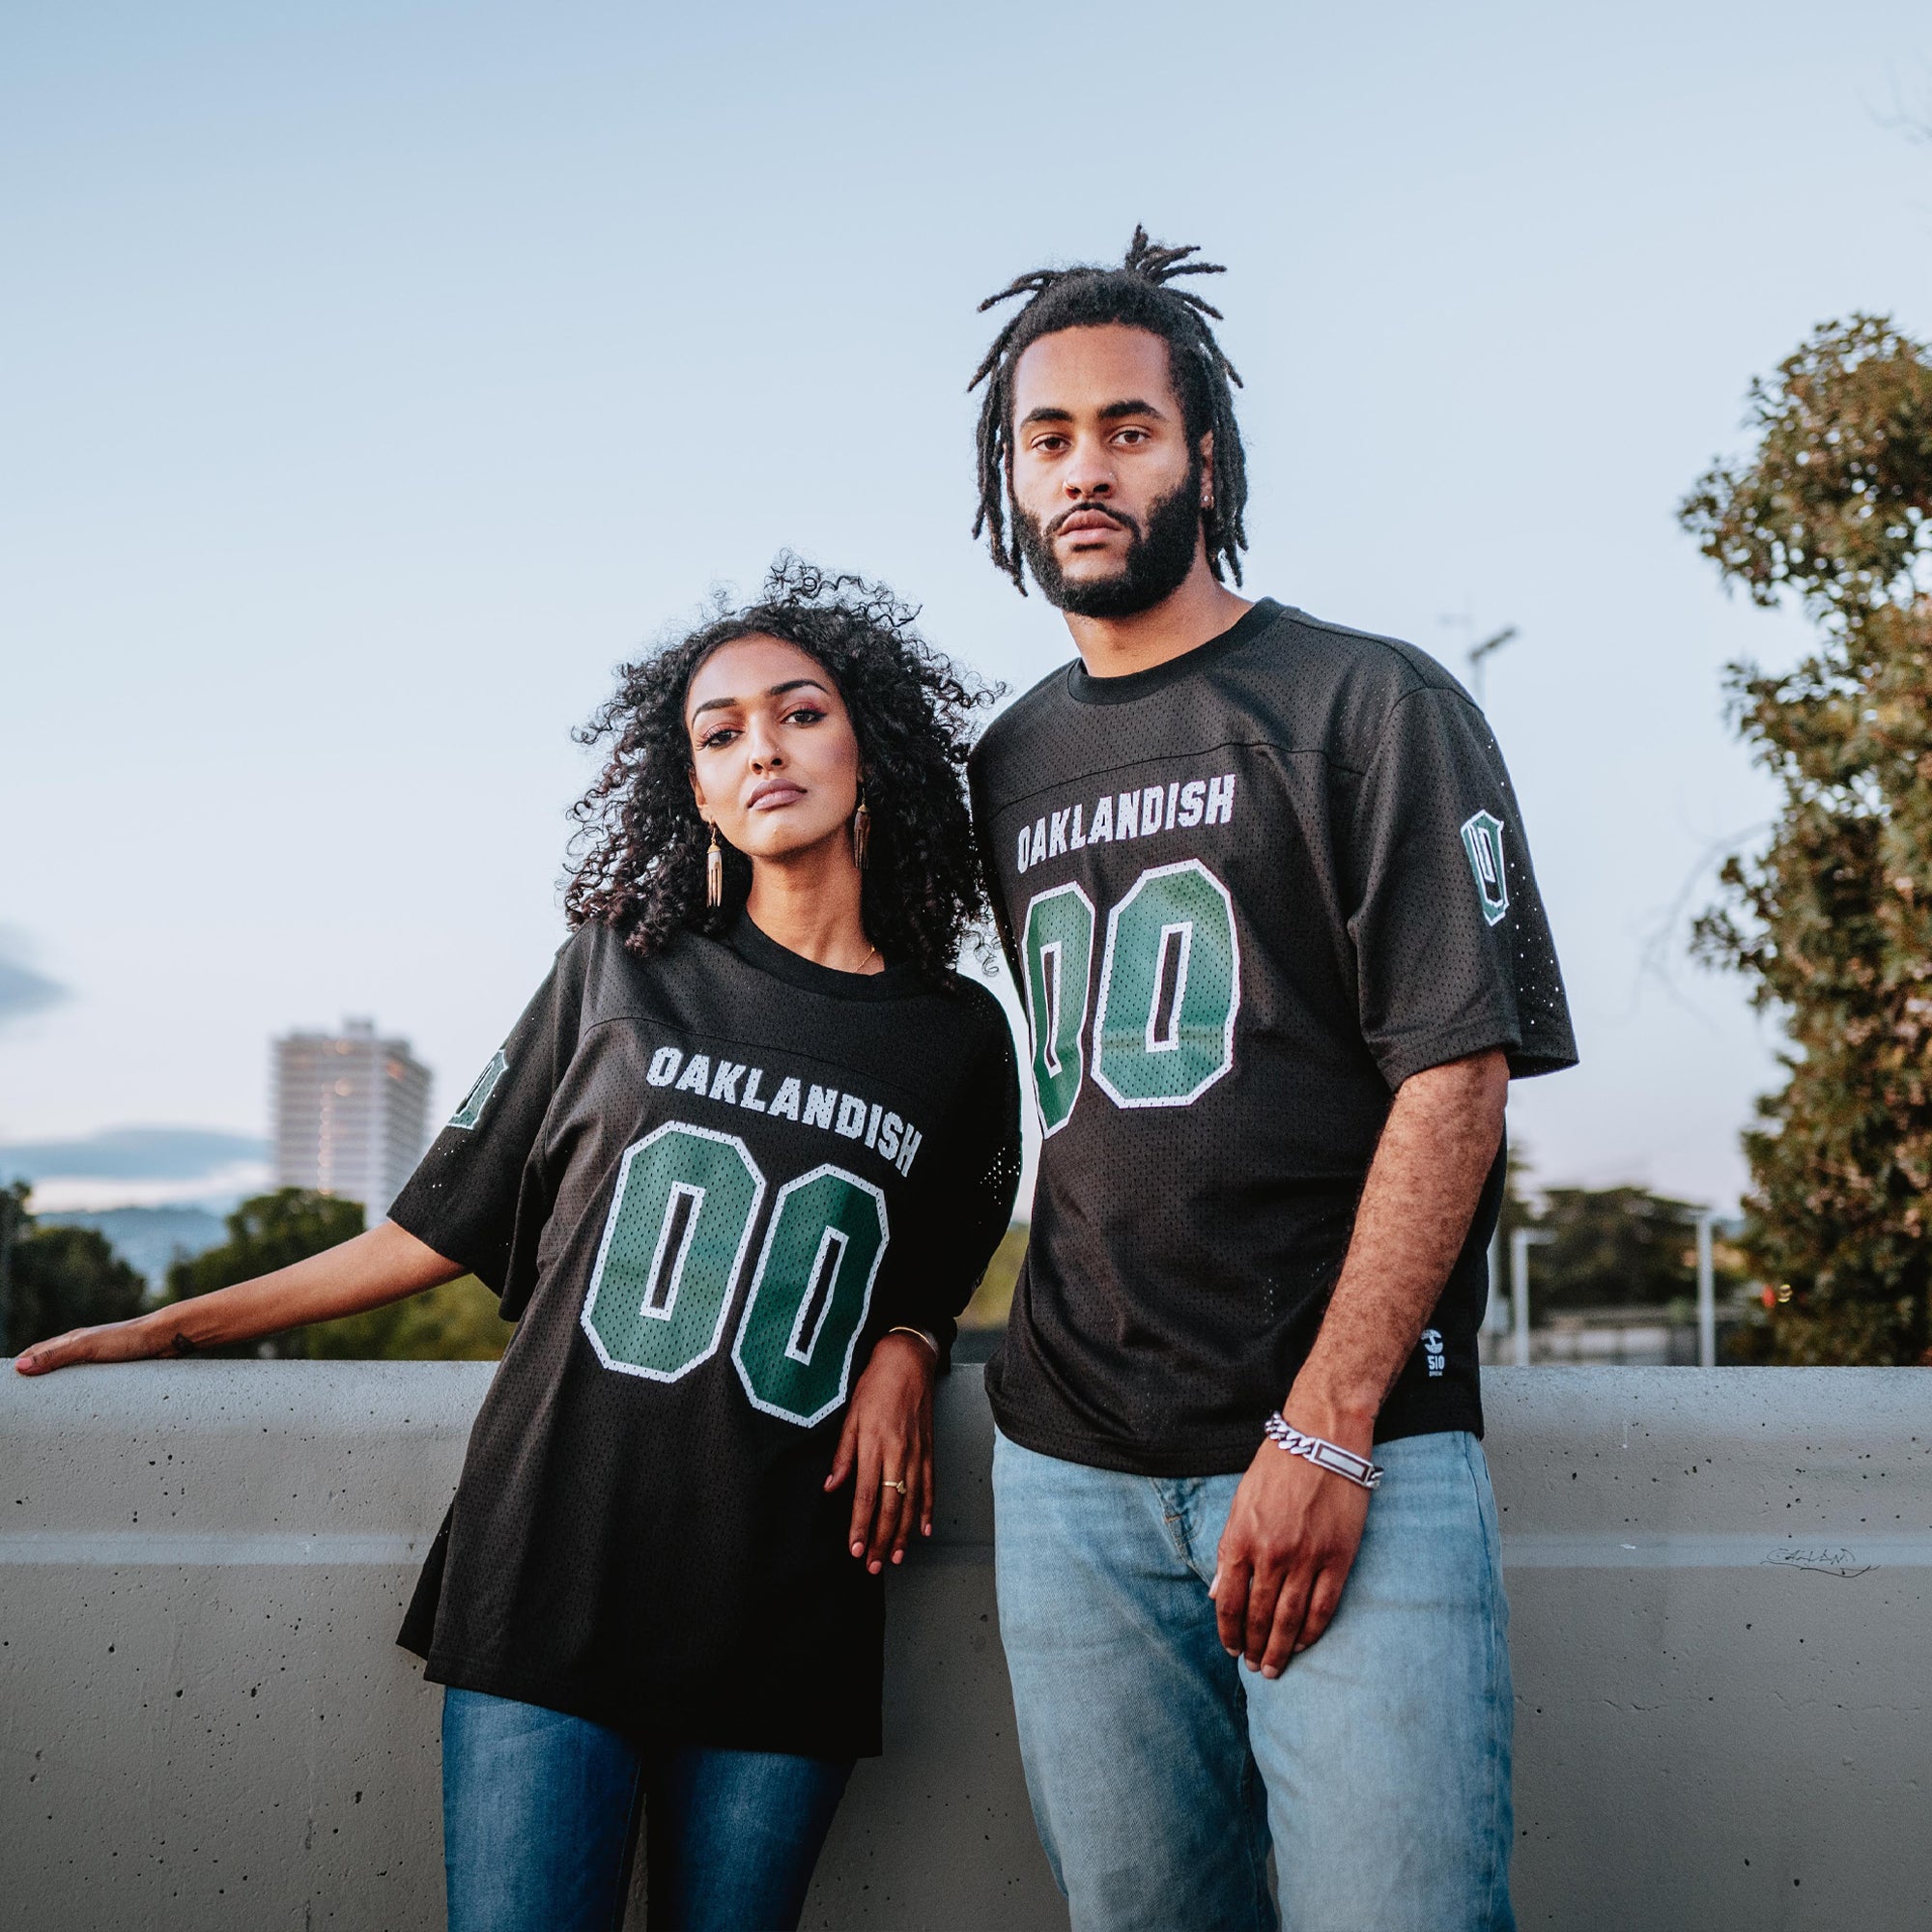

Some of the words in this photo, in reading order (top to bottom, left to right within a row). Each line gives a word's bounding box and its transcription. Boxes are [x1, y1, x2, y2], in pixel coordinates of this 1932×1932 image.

[1017, 774, 1236, 873] OAKLANDISH
[1022, 858, 1241, 1140] 00
[646, 1046, 923, 1178] OAKLANDISH
[580, 1120, 891, 1429] 00
[1427, 1354, 1445, 1370] 510
